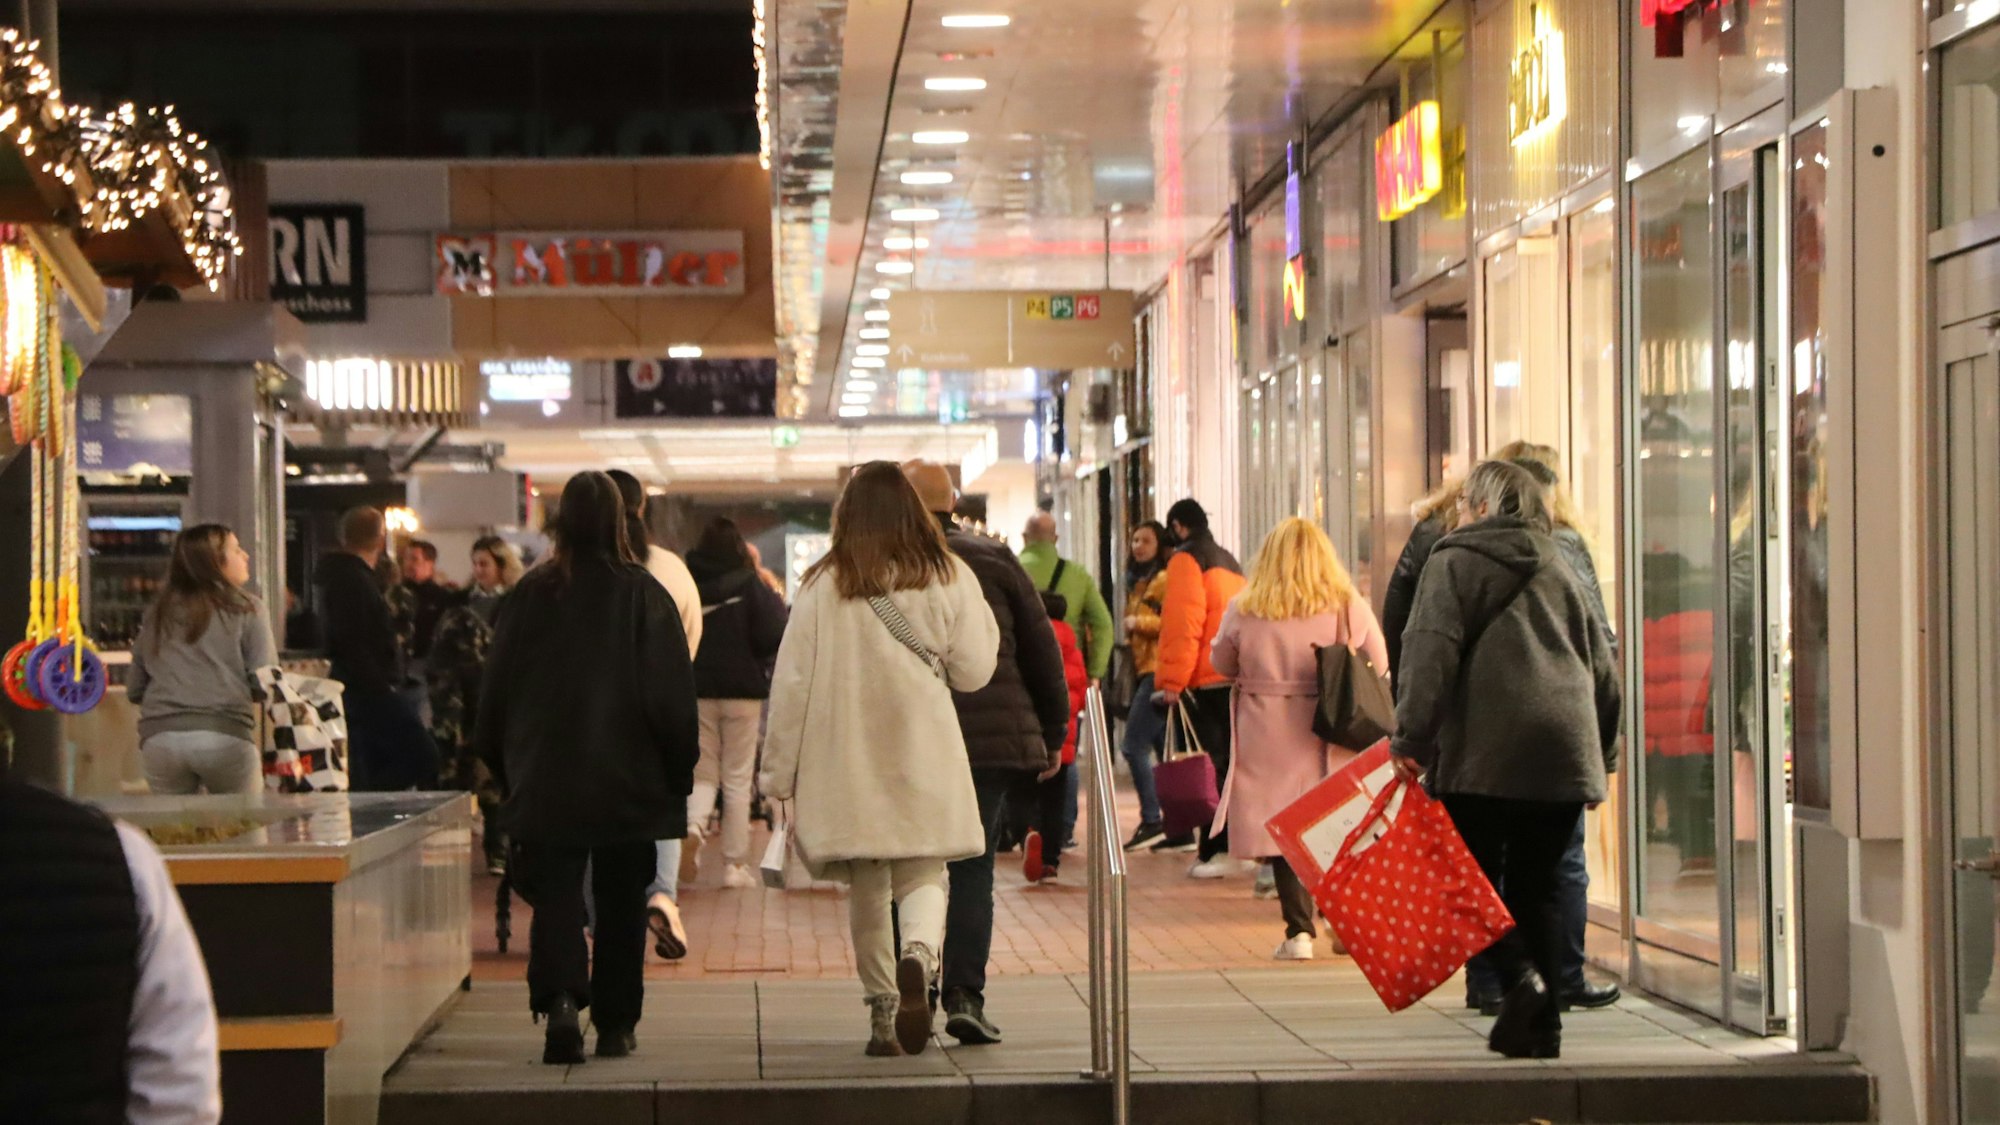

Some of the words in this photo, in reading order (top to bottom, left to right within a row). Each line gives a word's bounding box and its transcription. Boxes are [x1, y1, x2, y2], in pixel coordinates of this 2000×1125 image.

[511, 238, 738, 287] Müller
[1025, 298, 1046, 317] P4
[1052, 297, 1072, 318] P5
[1077, 297, 1098, 318] P6
